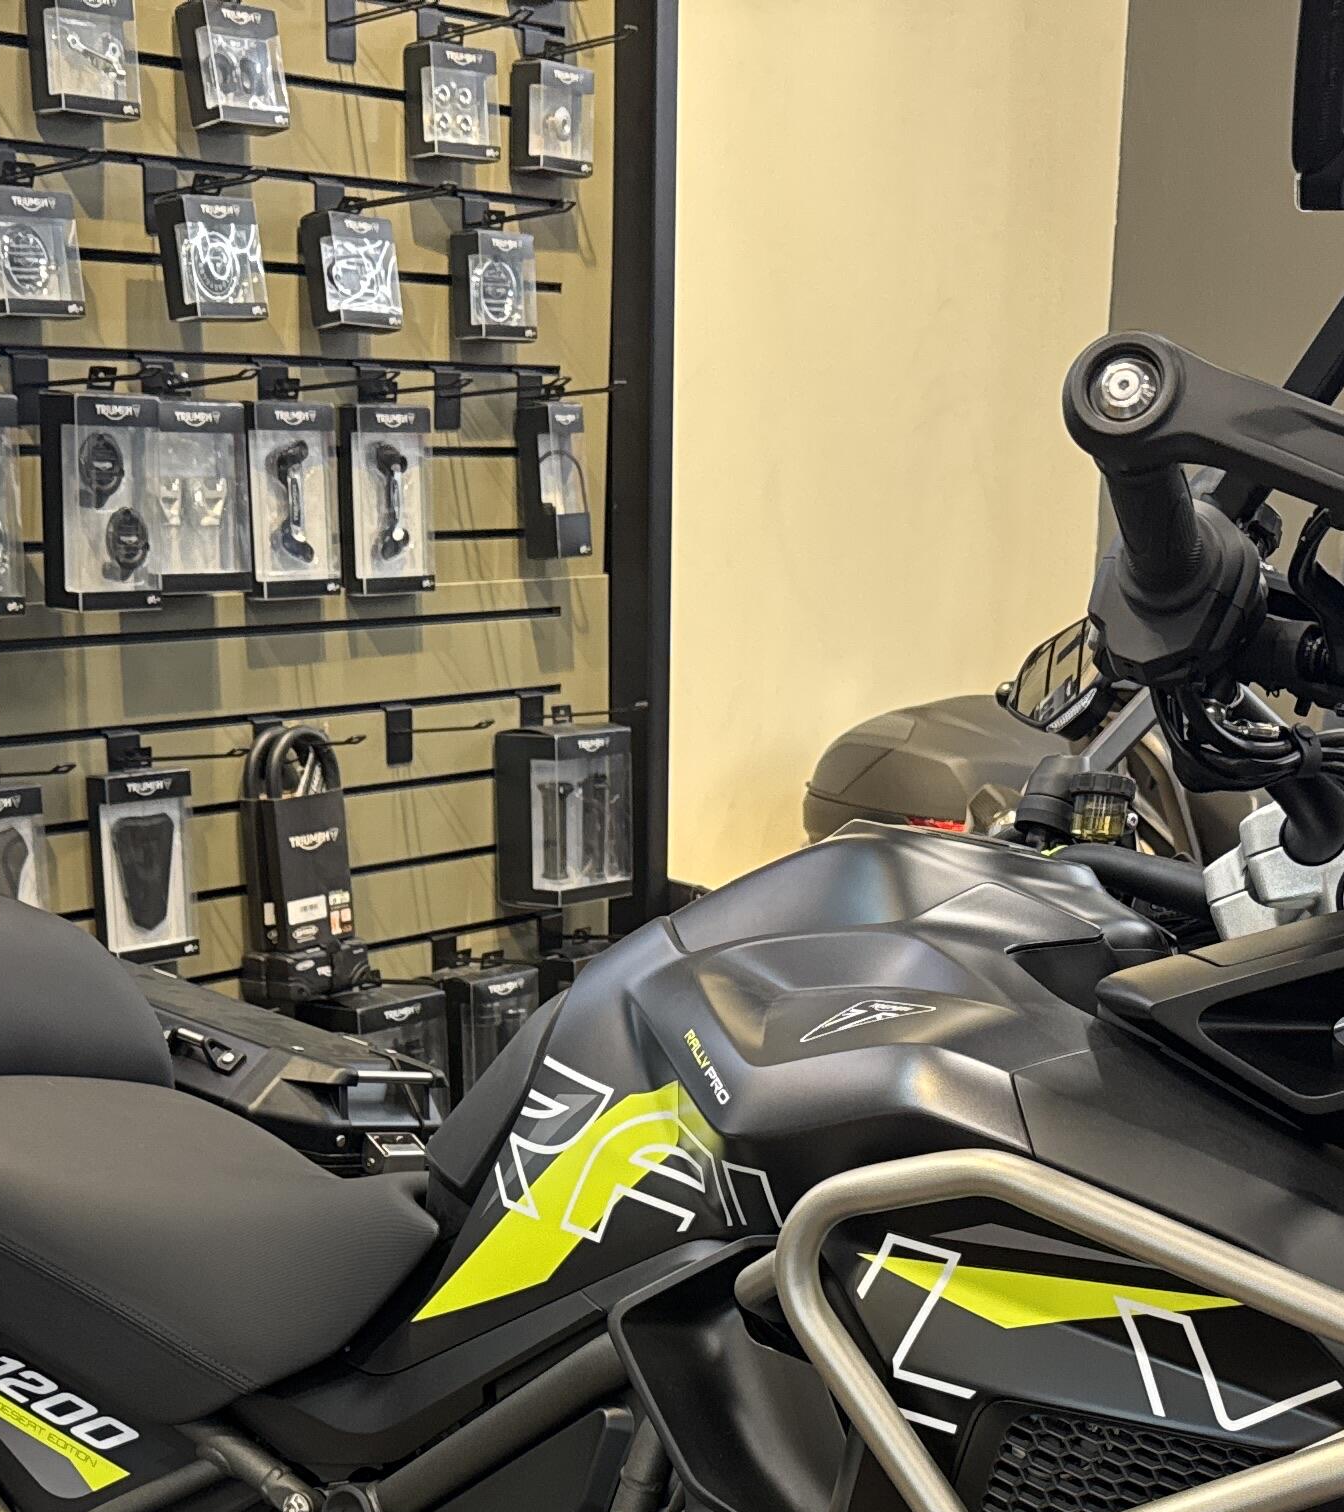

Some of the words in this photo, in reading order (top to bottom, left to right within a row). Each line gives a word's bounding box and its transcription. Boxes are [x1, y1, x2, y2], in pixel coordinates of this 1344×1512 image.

[95, 403, 134, 421] TRIUMPH
[175, 411, 213, 427] TRIUMPH
[126, 779, 164, 797] TRIUMPH
[288, 832, 330, 851] TRIUMPH
[683, 1028, 711, 1069] RALLY
[704, 1066, 731, 1105] PRO
[47, 1431, 98, 1468] EDITION
